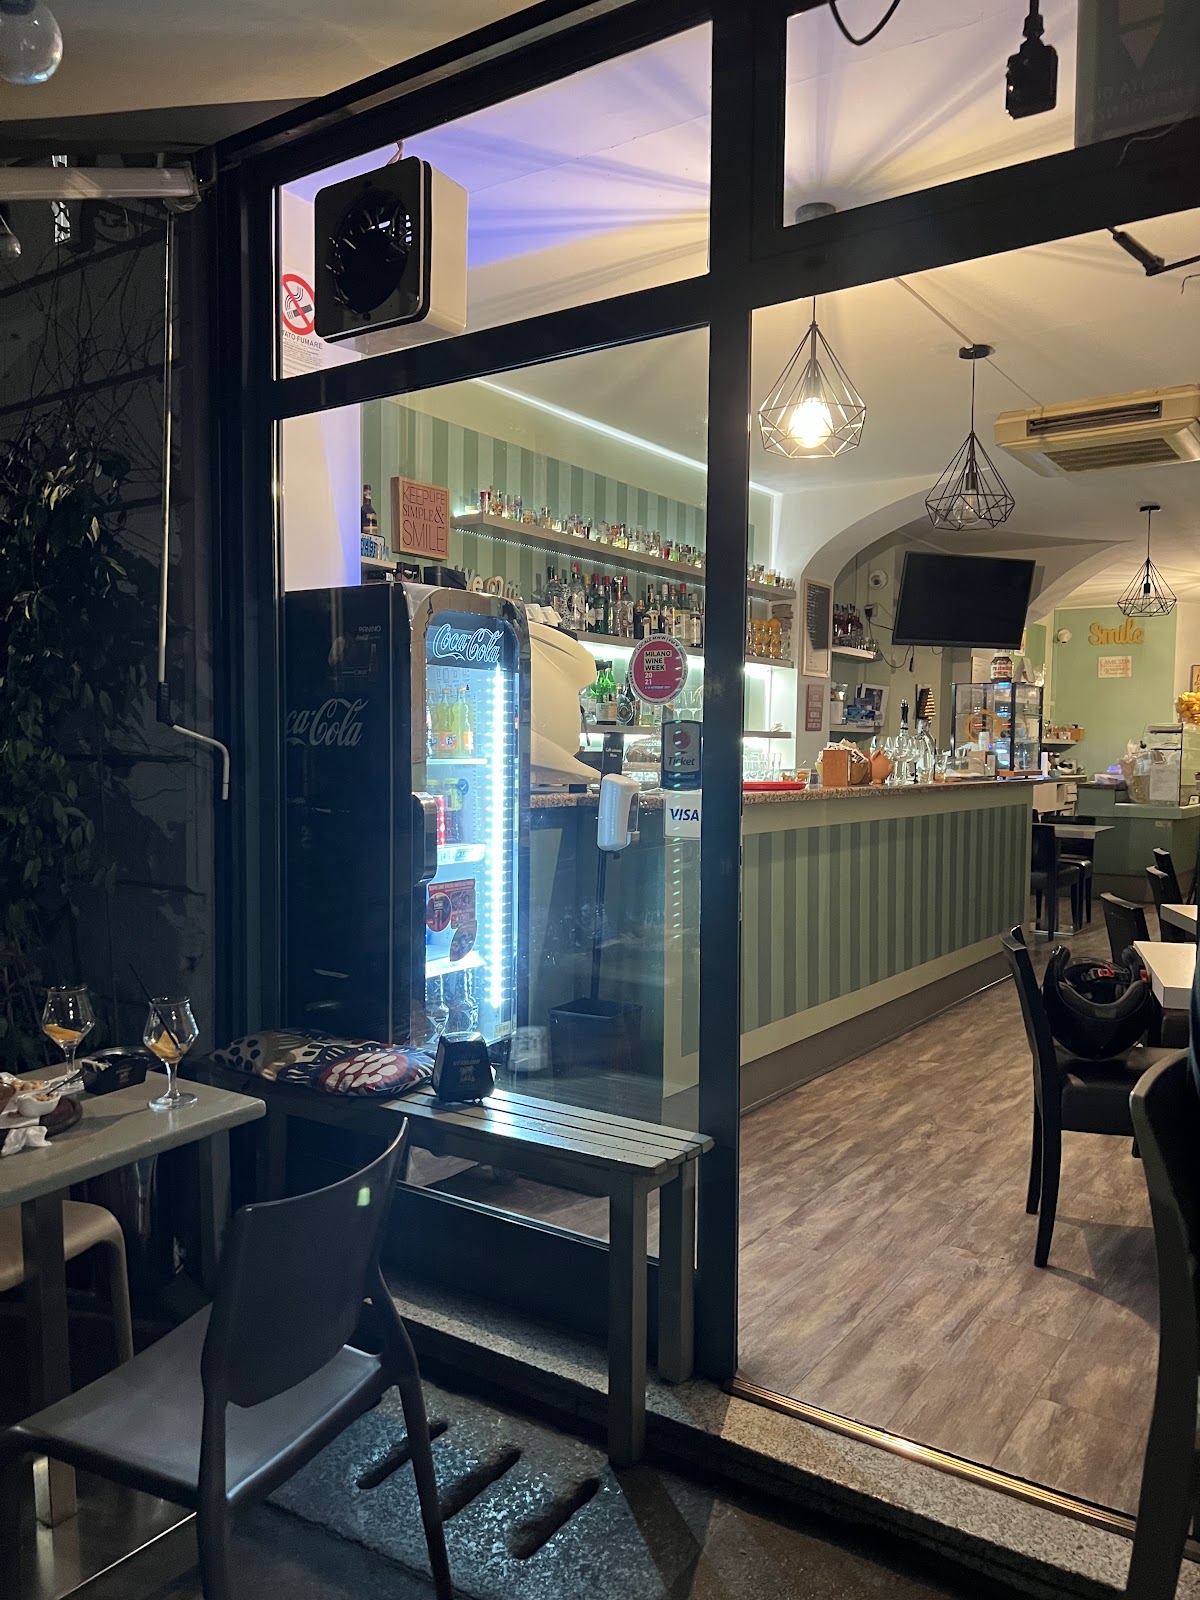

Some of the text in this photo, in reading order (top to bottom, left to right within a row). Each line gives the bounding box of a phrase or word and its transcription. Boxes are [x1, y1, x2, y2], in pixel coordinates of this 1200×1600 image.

[296, 336, 323, 350] FUMARE
[402, 484, 445, 506] KEEP LIFE
[402, 519, 445, 552] SMILE
[1088, 617, 1145, 645] Smile
[668, 756, 695, 766] Ticket
[669, 808, 699, 821] VISA
